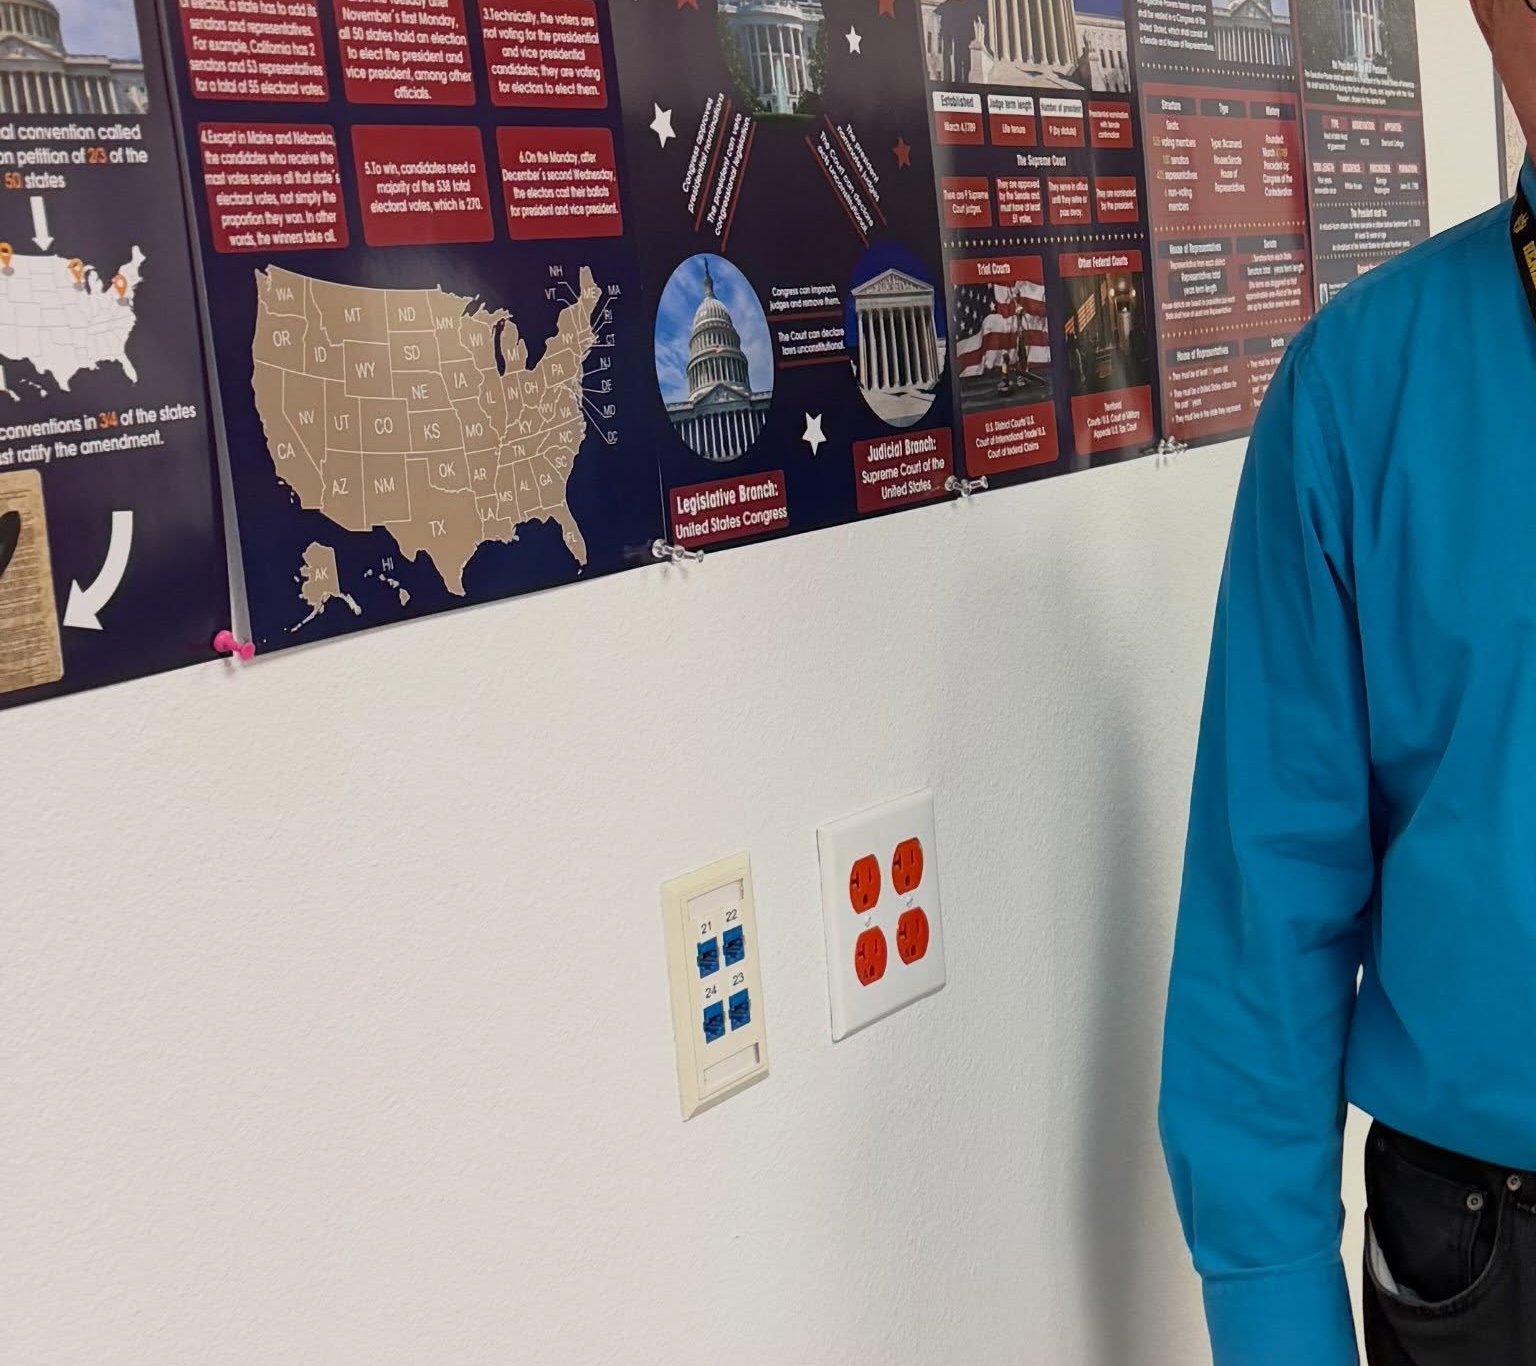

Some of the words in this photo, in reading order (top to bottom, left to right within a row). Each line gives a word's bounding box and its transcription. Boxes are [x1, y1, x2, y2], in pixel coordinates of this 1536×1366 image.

[16, 122, 96, 140] convention
[96, 123, 142, 140] called
[4, 171, 22, 189] 50
[23, 171, 66, 189] states
[276, 287, 294, 302] WA
[345, 308, 361, 322] MT
[273, 331, 291, 347] OR
[355, 362, 375, 378] WY
[374, 417, 393, 435] CO
[277, 443, 295, 460] CA
[866, 439, 902, 462] Judicial
[904, 436, 936, 455] Branch:
[861, 466, 899, 485] Supreme
[899, 459, 921, 476] Court
[922, 457, 931, 472] of
[931, 456, 945, 470] the
[374, 477, 395, 494] NM
[880, 481, 907, 499] United
[907, 479, 932, 494] States
[676, 487, 736, 516] Legislative
[738, 479, 778, 502] Branch:
[429, 520, 447, 537] TX
[674, 518, 709, 539] United
[709, 514, 741, 532] States
[741, 506, 787, 525] Congress
[701, 921, 712, 934] 21
[725, 908, 738, 922] 22
[705, 985, 717, 999] 24
[732, 972, 744, 986] 23
